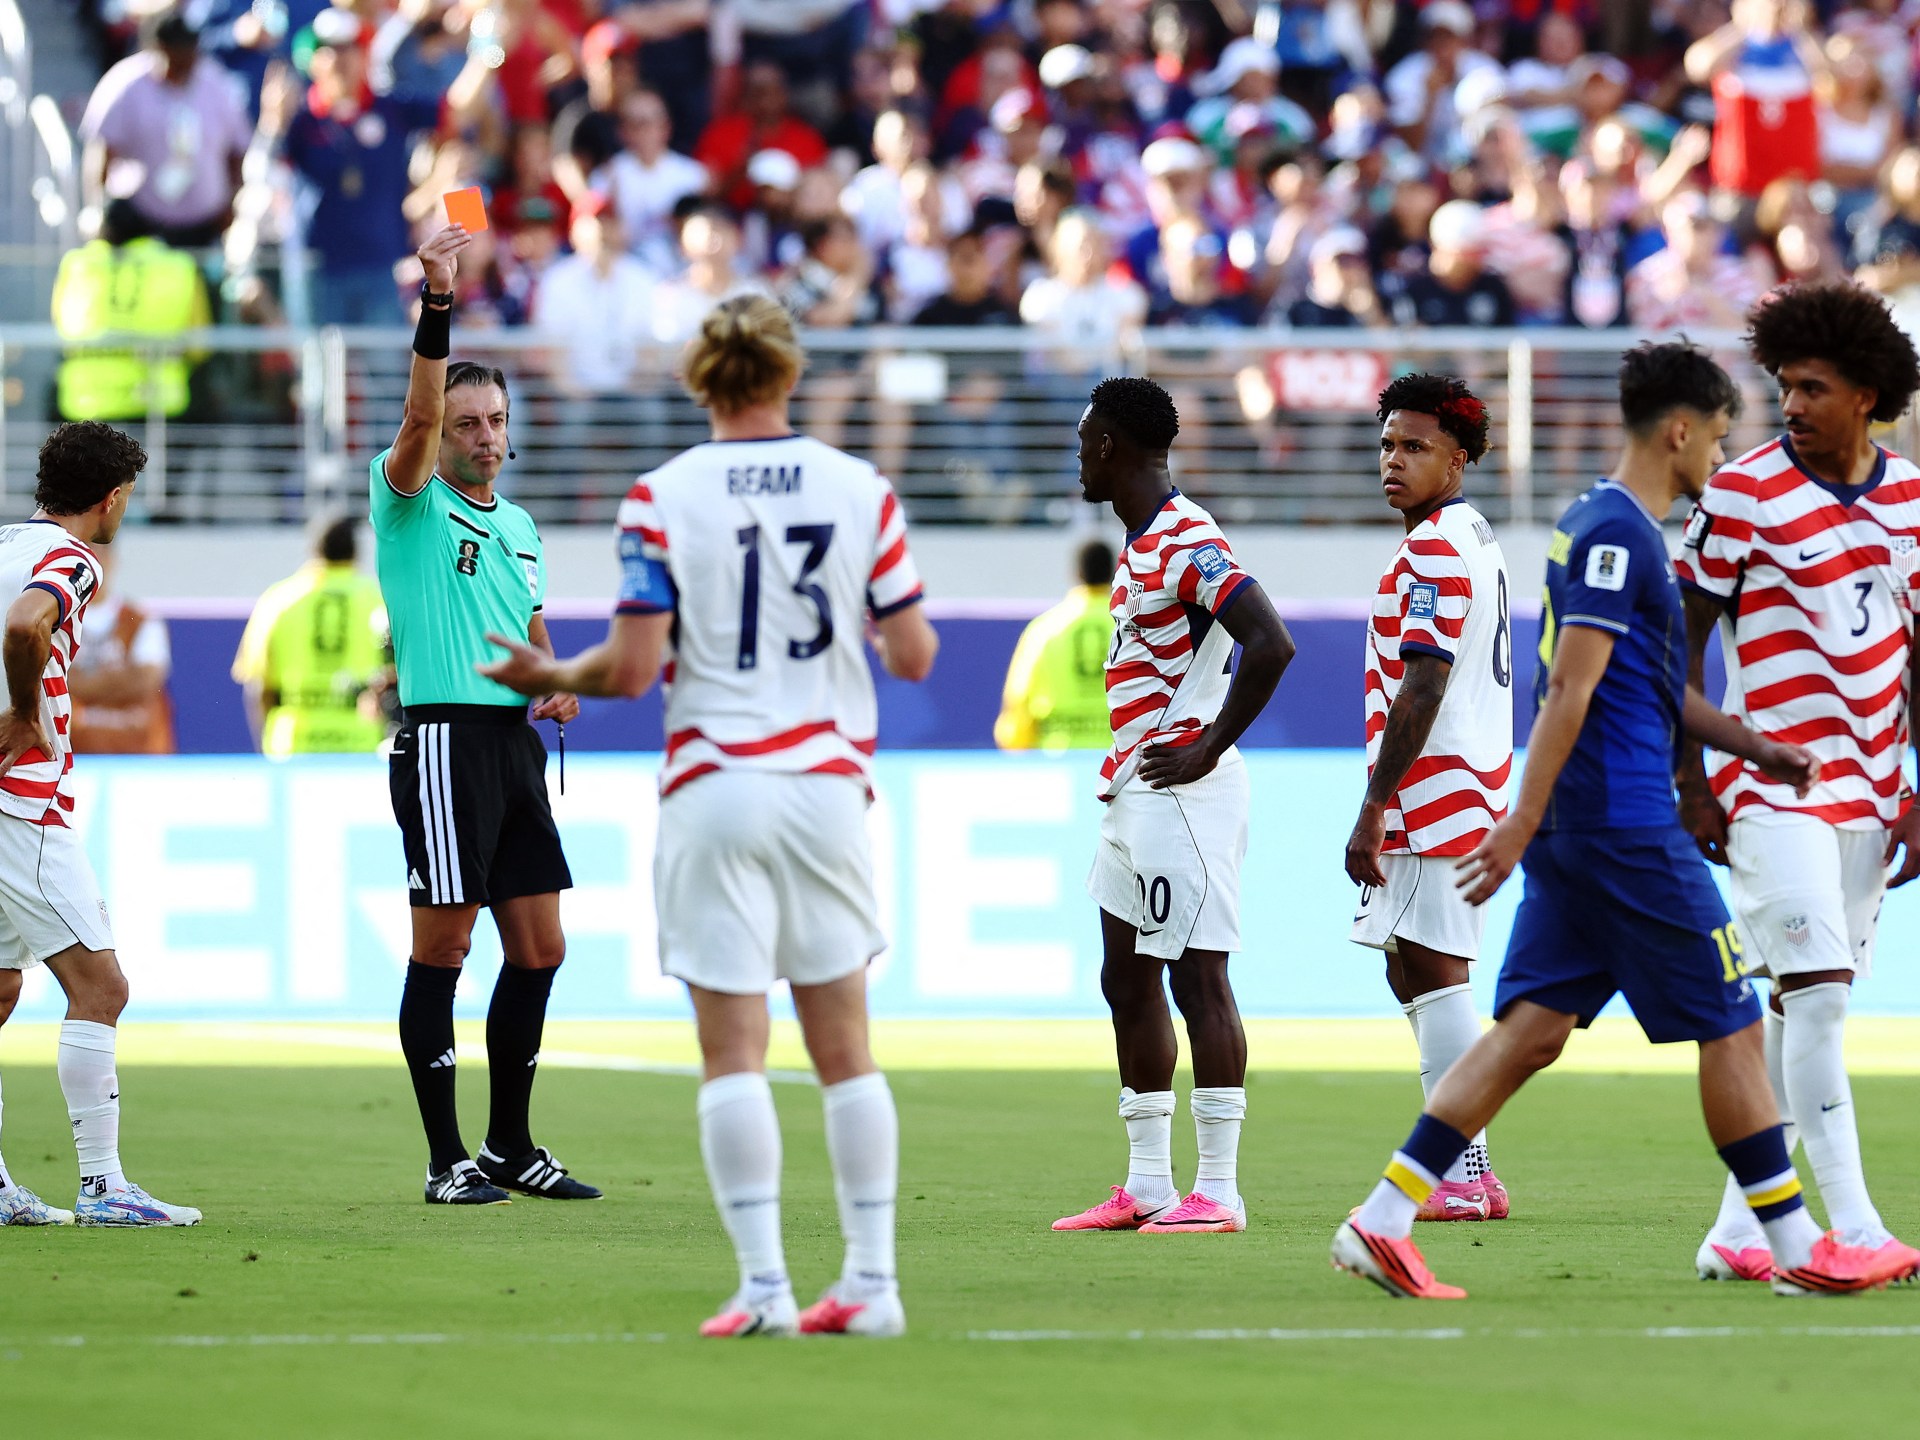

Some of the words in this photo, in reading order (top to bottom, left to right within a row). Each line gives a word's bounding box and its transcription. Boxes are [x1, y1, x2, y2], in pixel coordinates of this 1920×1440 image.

[727, 465, 802, 496] BEAM
[736, 522, 835, 671] 13
[1129, 581, 1144, 598] USA
[1412, 594, 1433, 603] UNITES
[1851, 582, 1873, 637] 3
[1492, 568, 1511, 688] 8
[1710, 921, 1749, 983] 19
